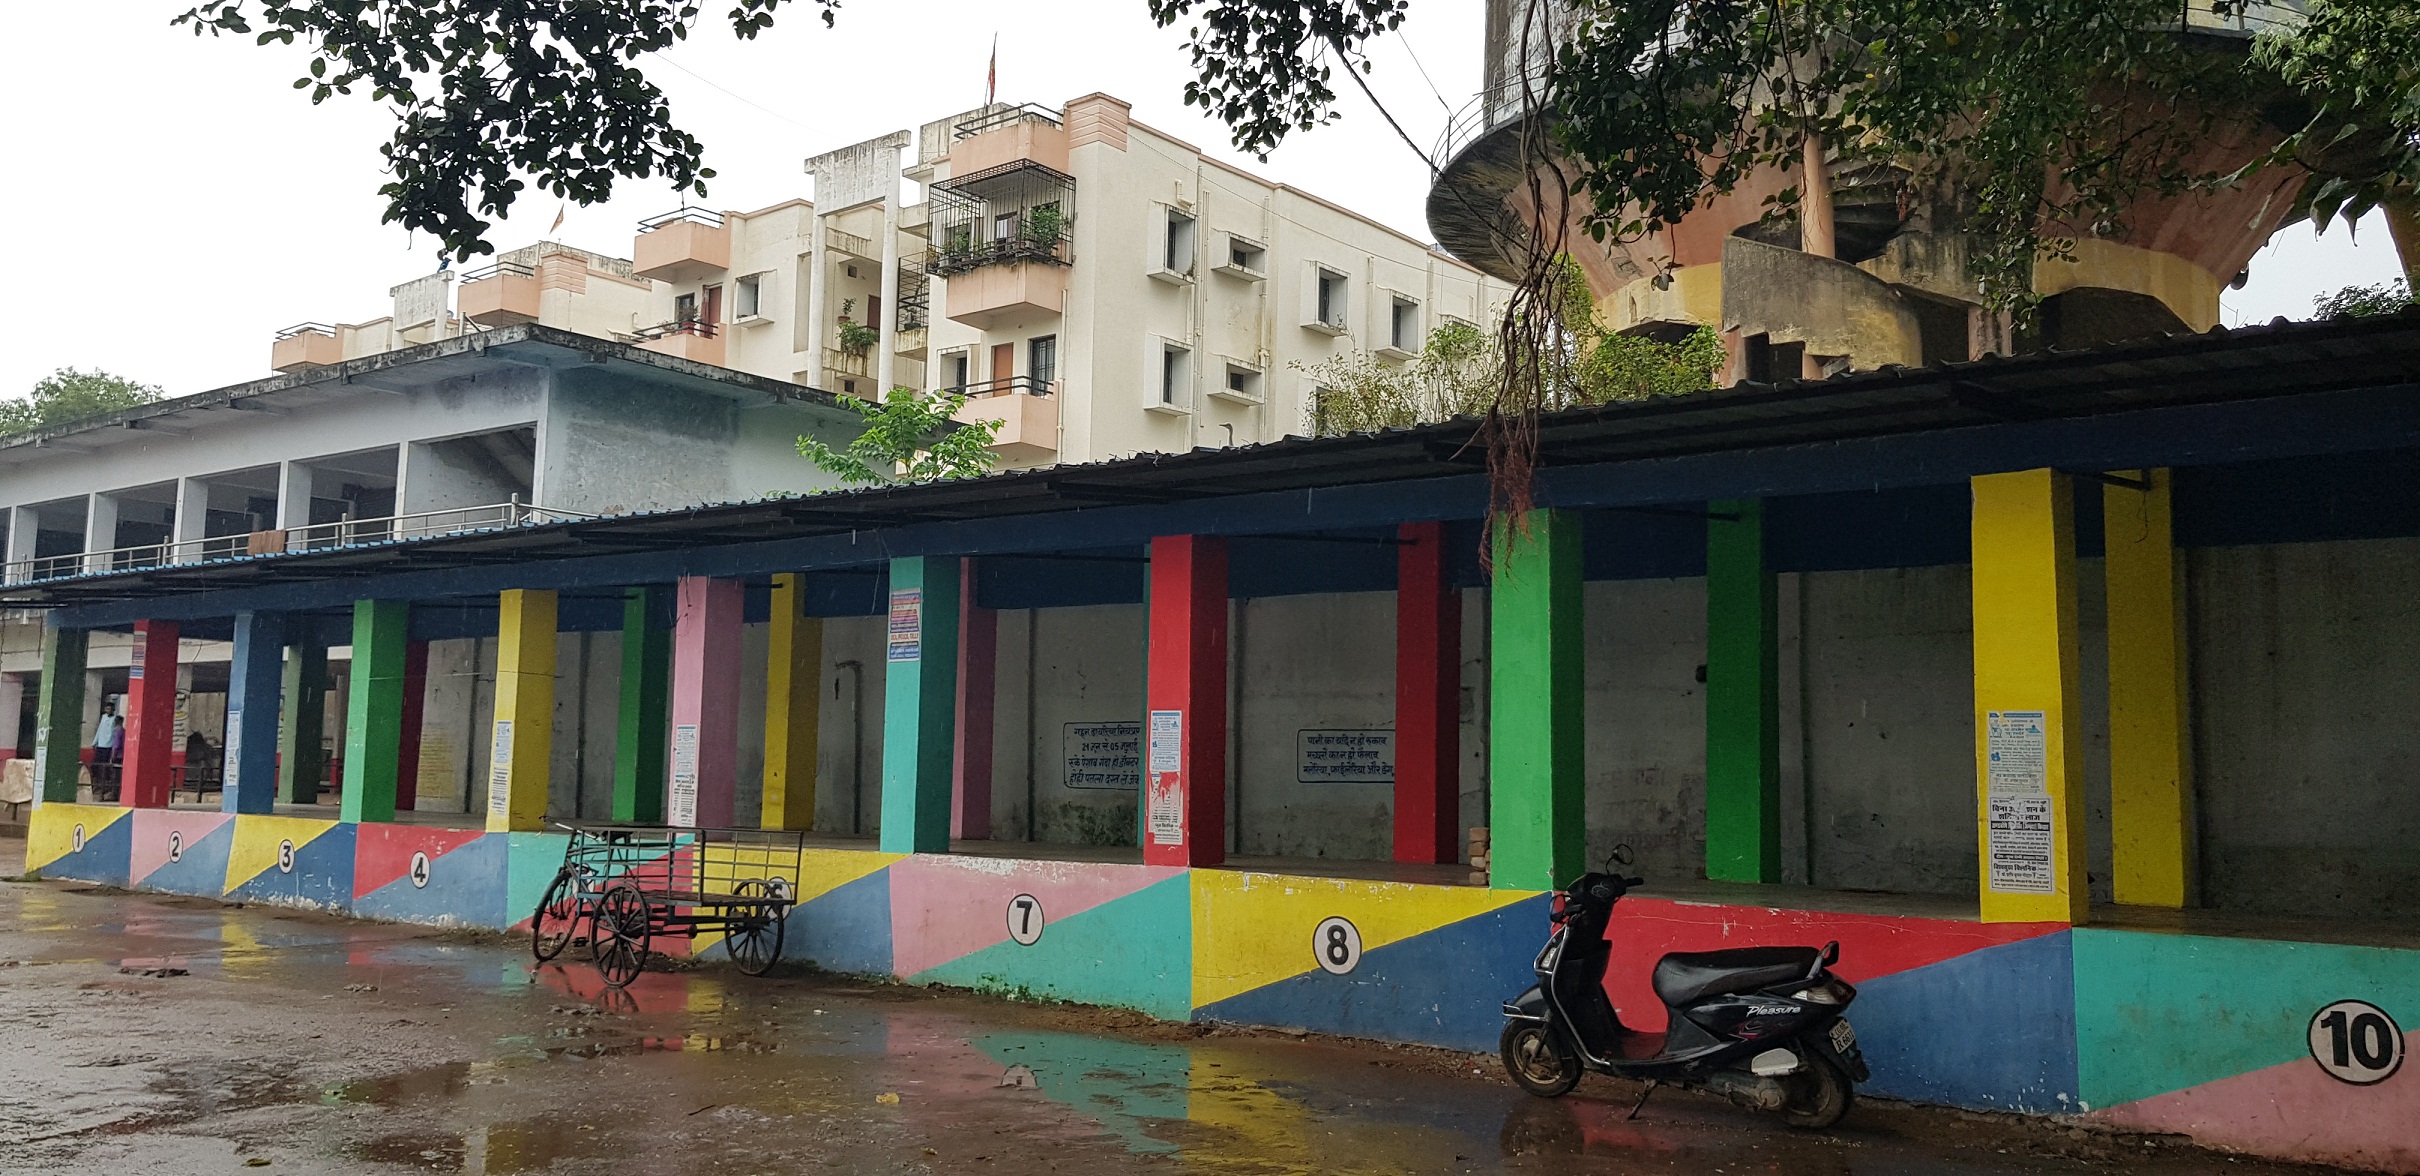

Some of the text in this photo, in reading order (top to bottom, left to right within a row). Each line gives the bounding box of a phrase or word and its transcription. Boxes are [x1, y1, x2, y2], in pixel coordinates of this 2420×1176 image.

[1110, 742, 1119, 750] 05
[76, 828, 81, 848] 1
[172, 836, 180, 857] 2
[282, 845, 291, 867] 3
[414, 857, 426, 882] 4
[1016, 901, 1033, 935] 7
[1326, 924, 1349, 966] 8
[1746, 1005, 1801, 1018] Pleasure
[2320, 1010, 2393, 1071] 10
